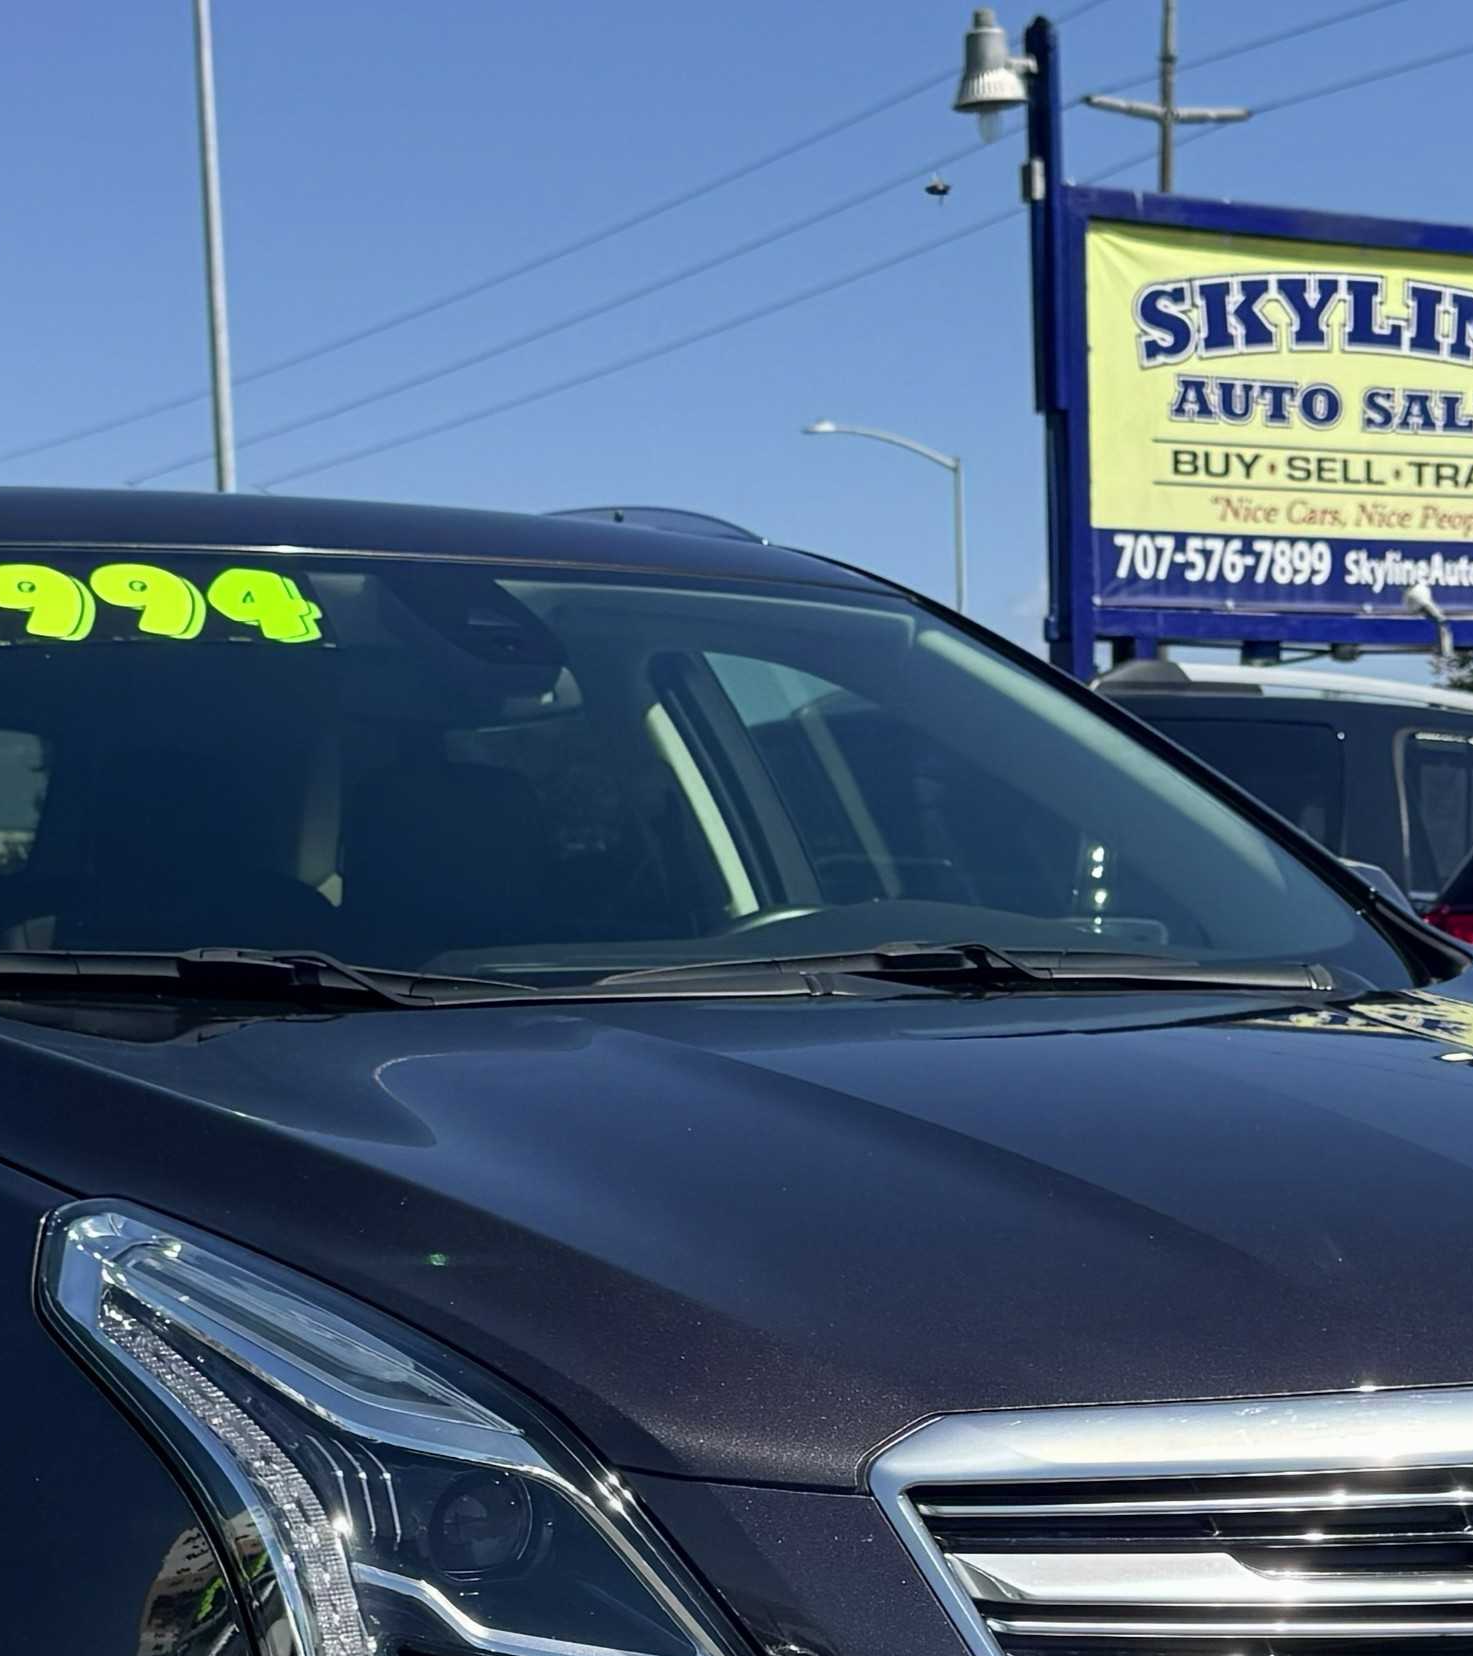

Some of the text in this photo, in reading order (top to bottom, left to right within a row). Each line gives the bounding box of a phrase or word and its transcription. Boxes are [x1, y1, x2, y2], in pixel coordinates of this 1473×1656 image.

[1169, 374, 1344, 431] AUTO
[1171, 449, 1262, 478] BUY
[1286, 456, 1386, 486] SELL
[1286, 500, 1347, 528] Cars,
[1354, 504, 1415, 529] Nice
[1113, 534, 1332, 586] 707-576-7899
